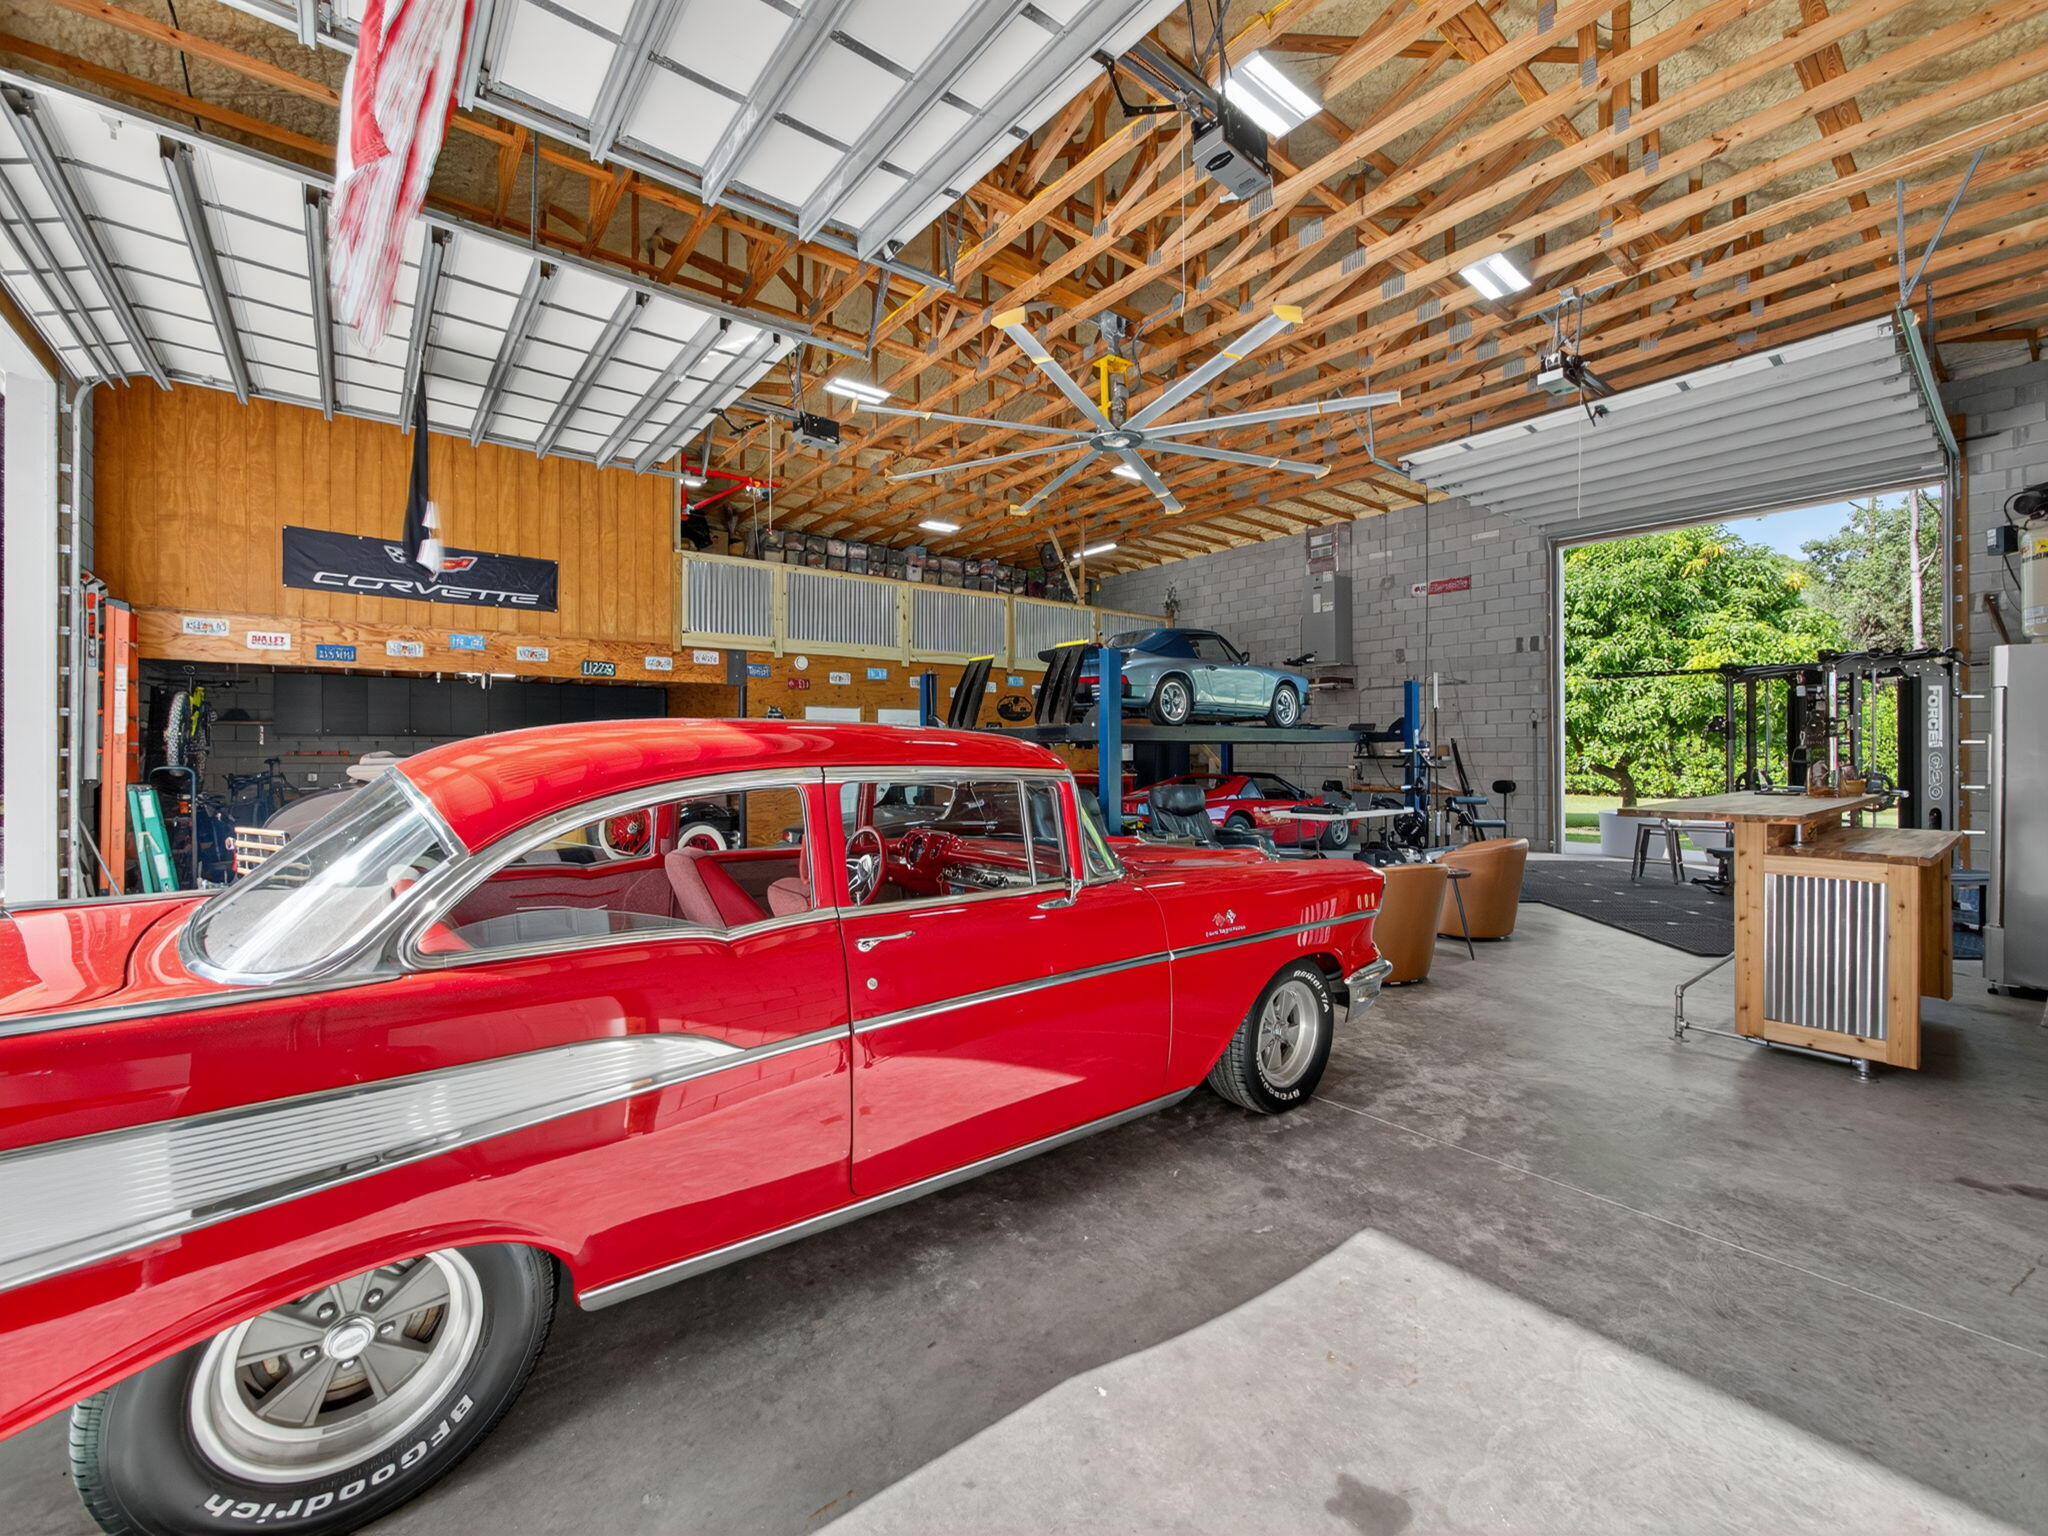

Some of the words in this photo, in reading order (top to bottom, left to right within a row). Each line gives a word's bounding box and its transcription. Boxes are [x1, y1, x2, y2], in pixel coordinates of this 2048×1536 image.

[313, 571, 540, 605] CORVETTE
[1927, 684, 1943, 742] FORCE
[203, 1394, 474, 1524] BFGoodrich
